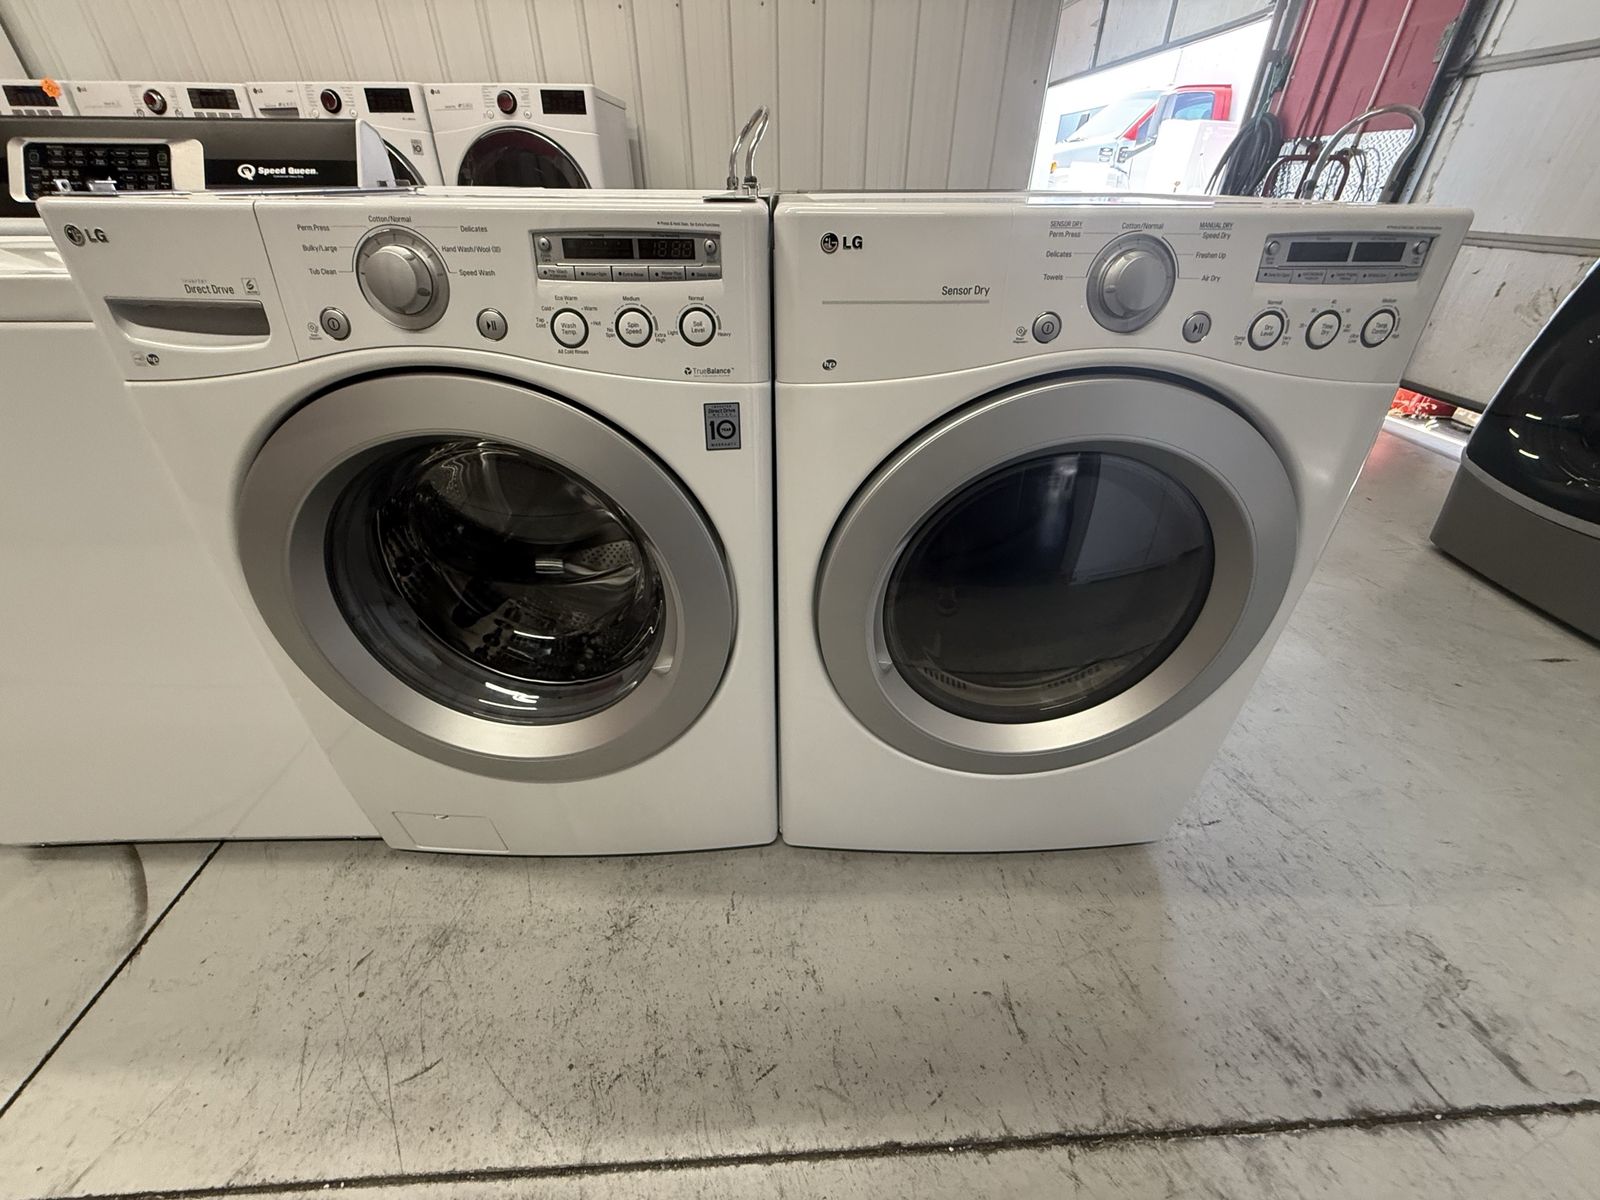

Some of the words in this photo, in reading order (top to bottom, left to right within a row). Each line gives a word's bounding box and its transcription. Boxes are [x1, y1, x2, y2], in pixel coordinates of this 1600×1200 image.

[257, 166, 286, 176] Speed
[287, 166, 316, 175] Queen
[368, 215, 412, 223] Cotton/Normal
[84, 228, 109, 243] LG
[1202, 231, 1220, 239] Speed
[1220, 231, 1231, 240] Dry
[842, 235, 864, 250] LG
[302, 244, 338, 253] Bulky/Large
[1046, 250, 1072, 258] Delicates
[1195, 251, 1218, 259] Freshen
[1218, 252, 1227, 260] Up
[459, 269, 477, 277] Speed
[184, 284, 212, 294] Direct
[212, 285, 235, 294] Drive
[941, 285, 972, 296] Sensor
[974, 285, 990, 297] Dry
[709, 419, 736, 440] 10
